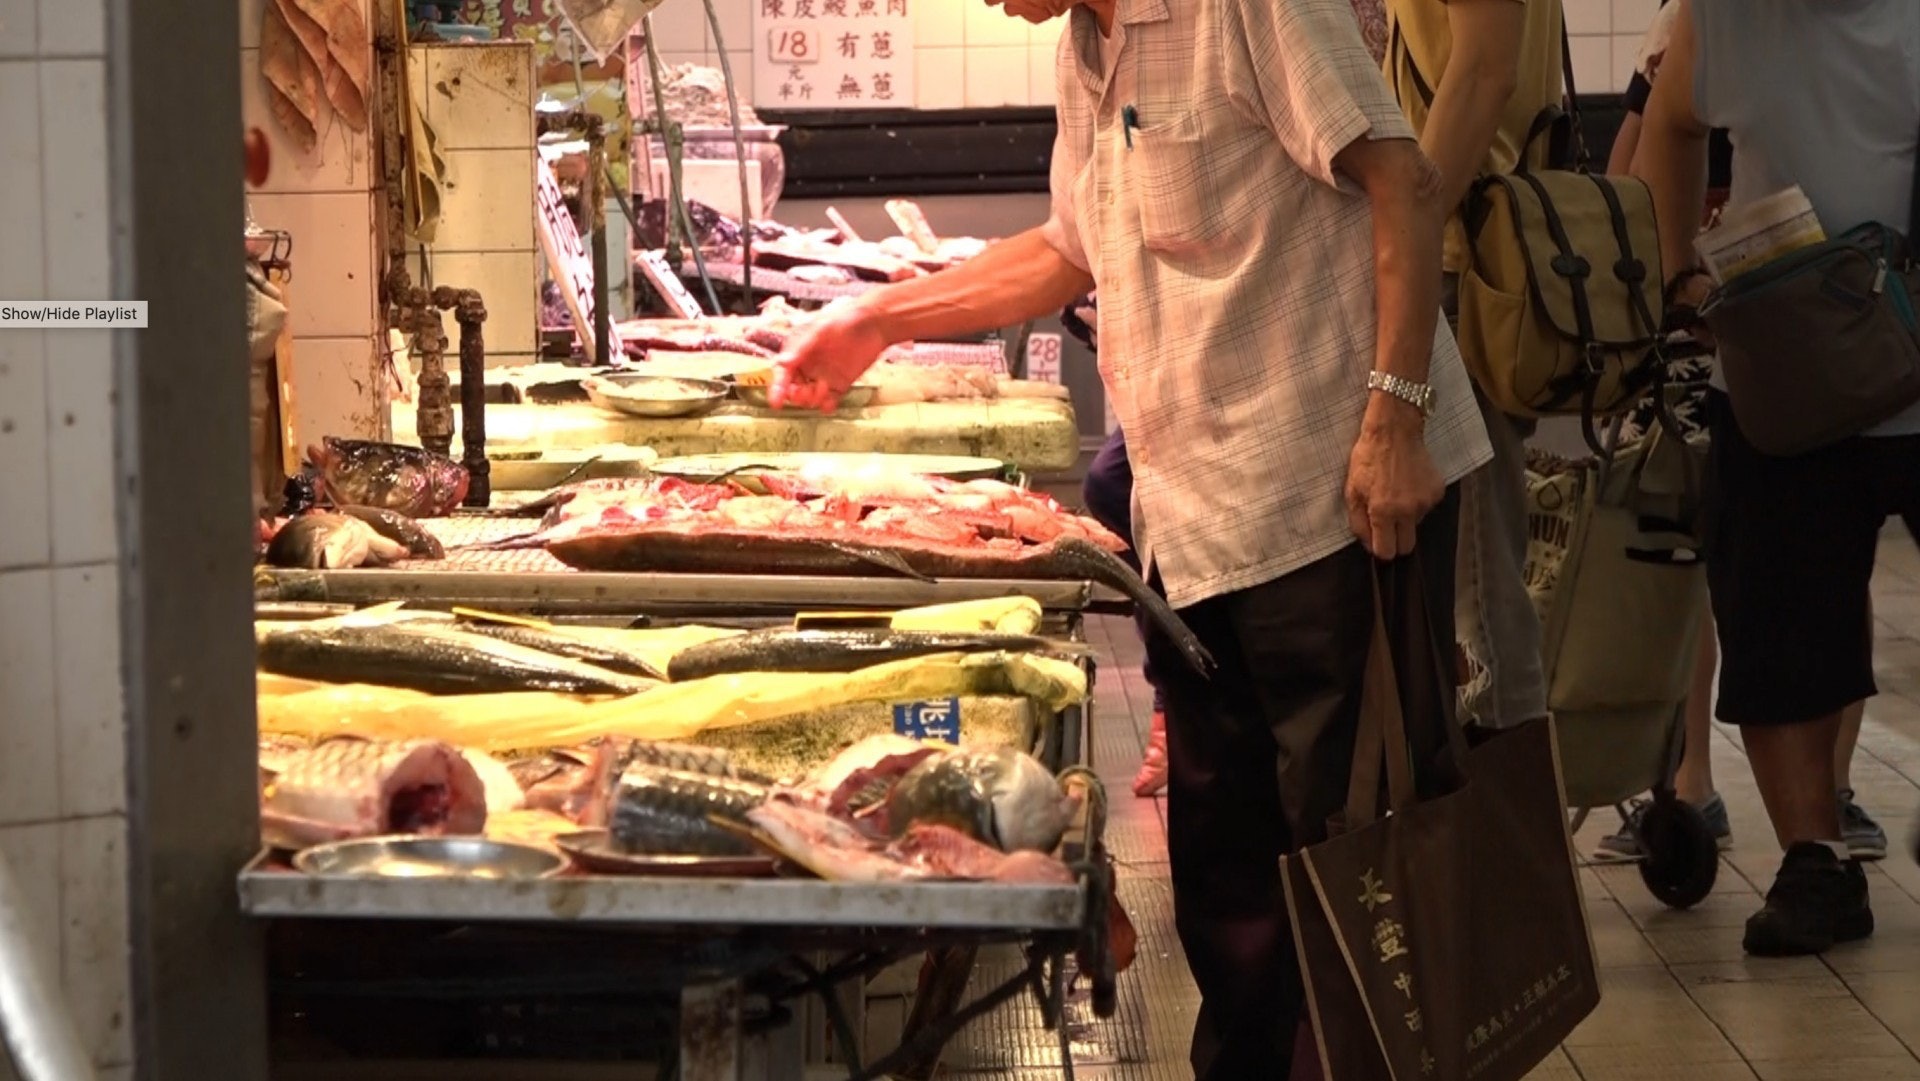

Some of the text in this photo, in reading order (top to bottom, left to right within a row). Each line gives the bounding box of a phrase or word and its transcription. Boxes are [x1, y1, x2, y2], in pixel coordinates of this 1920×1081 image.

[779, 31, 807, 57] 18
[789, 66, 804, 80] 元
[1030, 338, 1059, 362] 28
